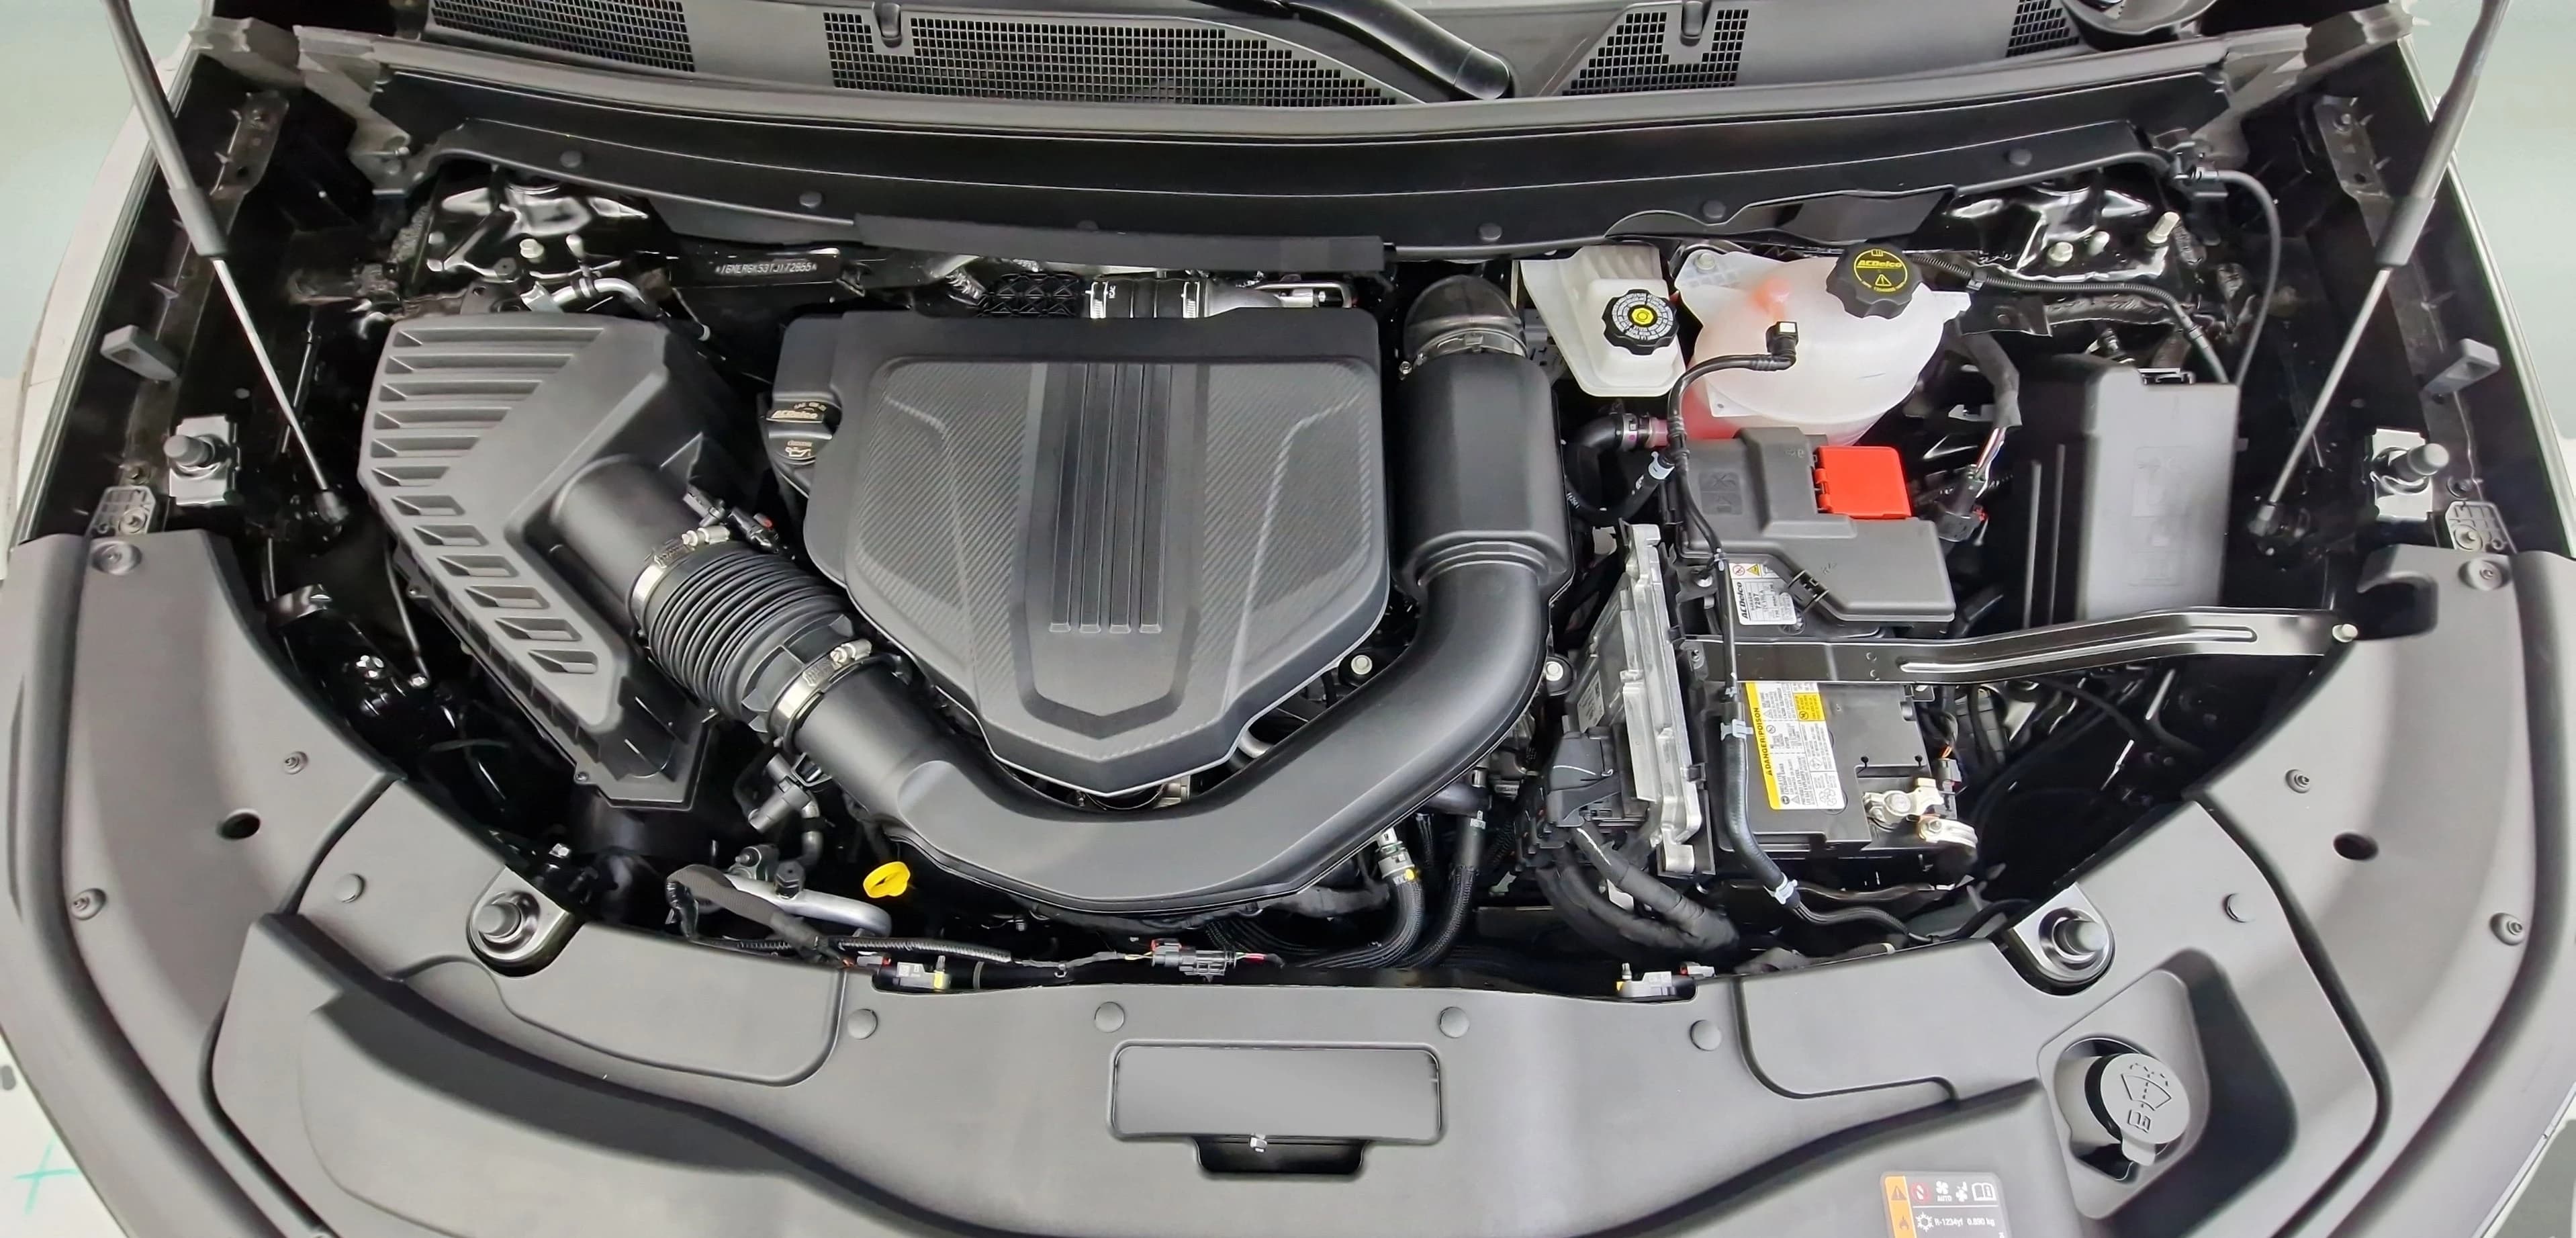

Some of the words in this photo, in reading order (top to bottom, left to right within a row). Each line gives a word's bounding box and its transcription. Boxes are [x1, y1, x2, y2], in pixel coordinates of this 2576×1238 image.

[1737, 582, 1748, 619] ACDelco
[1752, 707, 1772, 770] DANGER/POISON
[1986, 1217, 1995, 1227] kg
